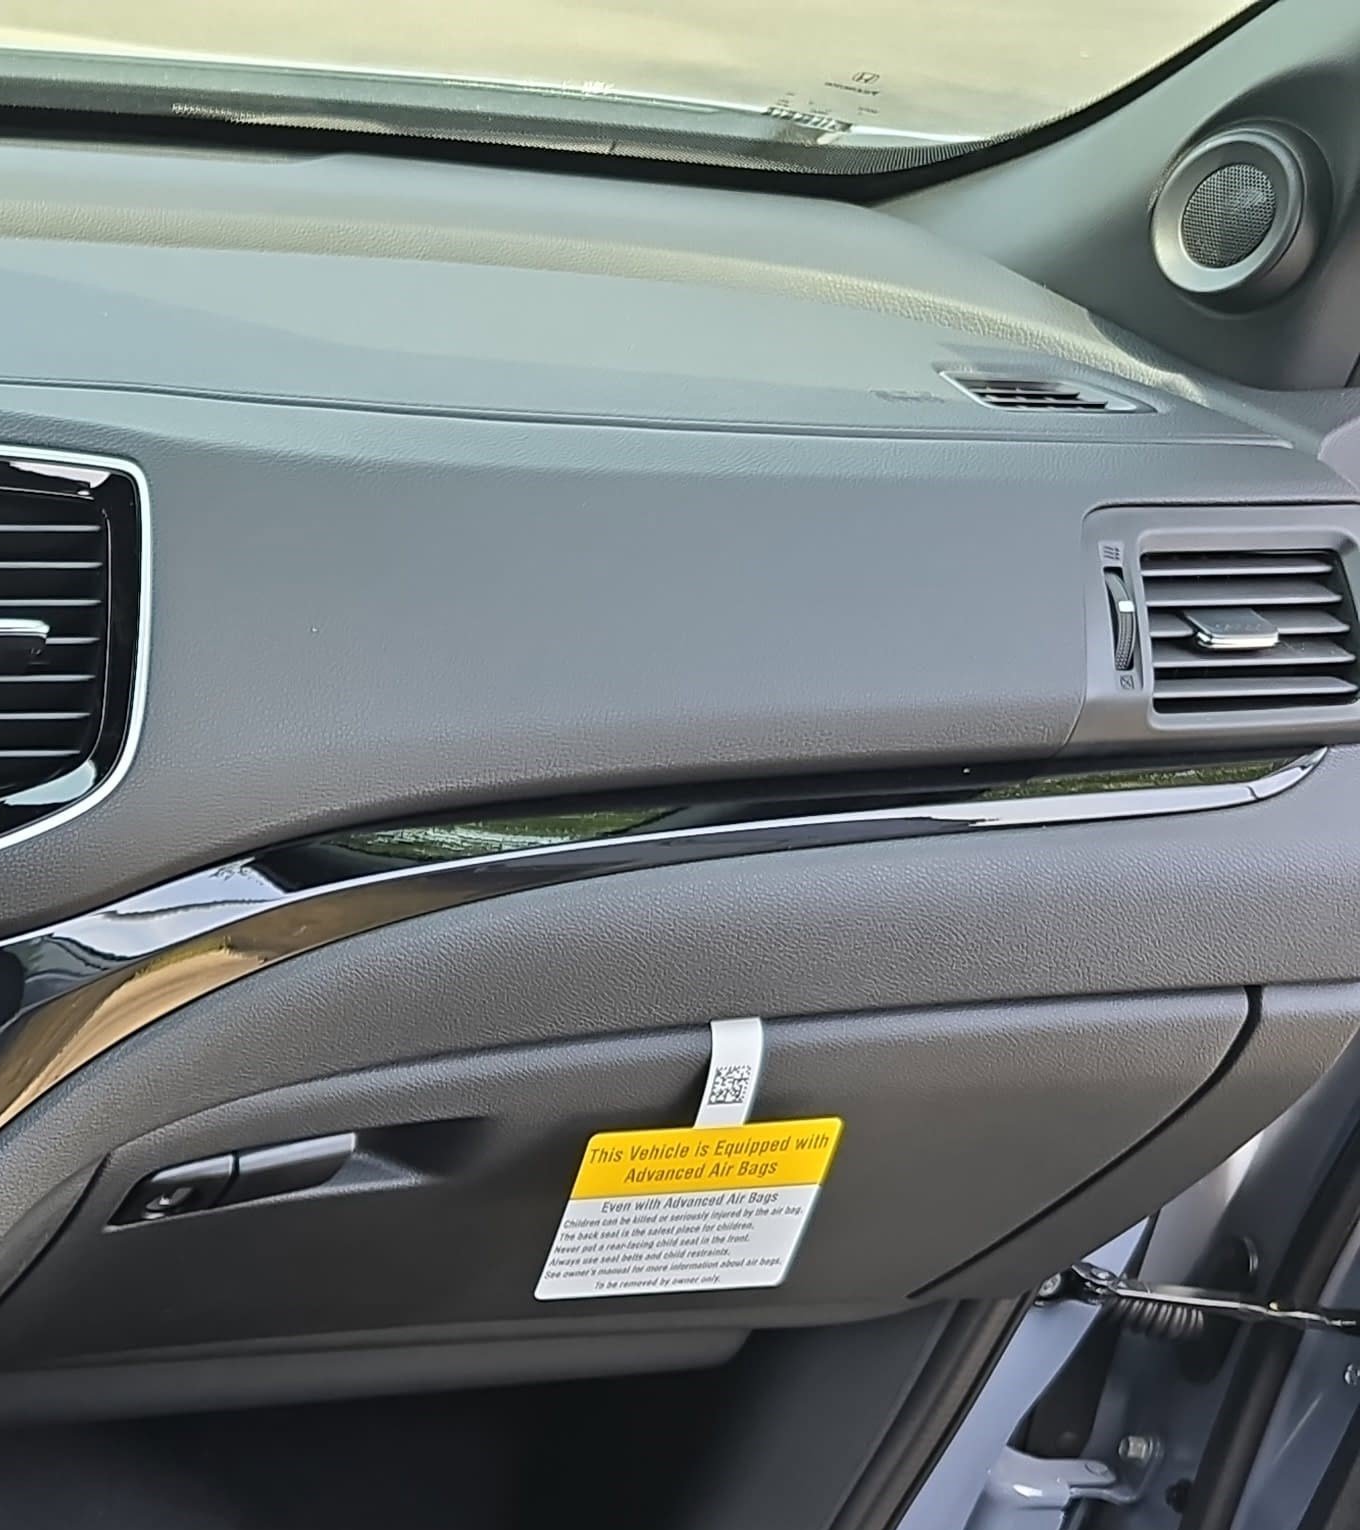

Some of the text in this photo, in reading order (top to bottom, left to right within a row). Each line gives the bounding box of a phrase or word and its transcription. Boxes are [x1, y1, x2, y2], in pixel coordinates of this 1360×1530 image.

[590, 1133, 829, 1164] This Vehicle is Equipped with
[625, 1161, 778, 1183] Advanced Air Bags
[601, 1192, 779, 1213] Even with Advanced Air Bags
[563, 1219, 600, 1229] Children
[602, 1218, 618, 1226] can
[620, 1216, 630, 1225] be
[632, 1215, 657, 1224] killed
[670, 1210, 709, 1221] seriously
[711, 1209, 740, 1220] injured
[743, 1208, 754, 1218] by
[755, 1207, 769, 1216] the
[770, 1207, 783, 1215] air
[785, 1206, 803, 1215] bag.
[560, 1222, 754, 1241] The back seat is the safest place for children.
